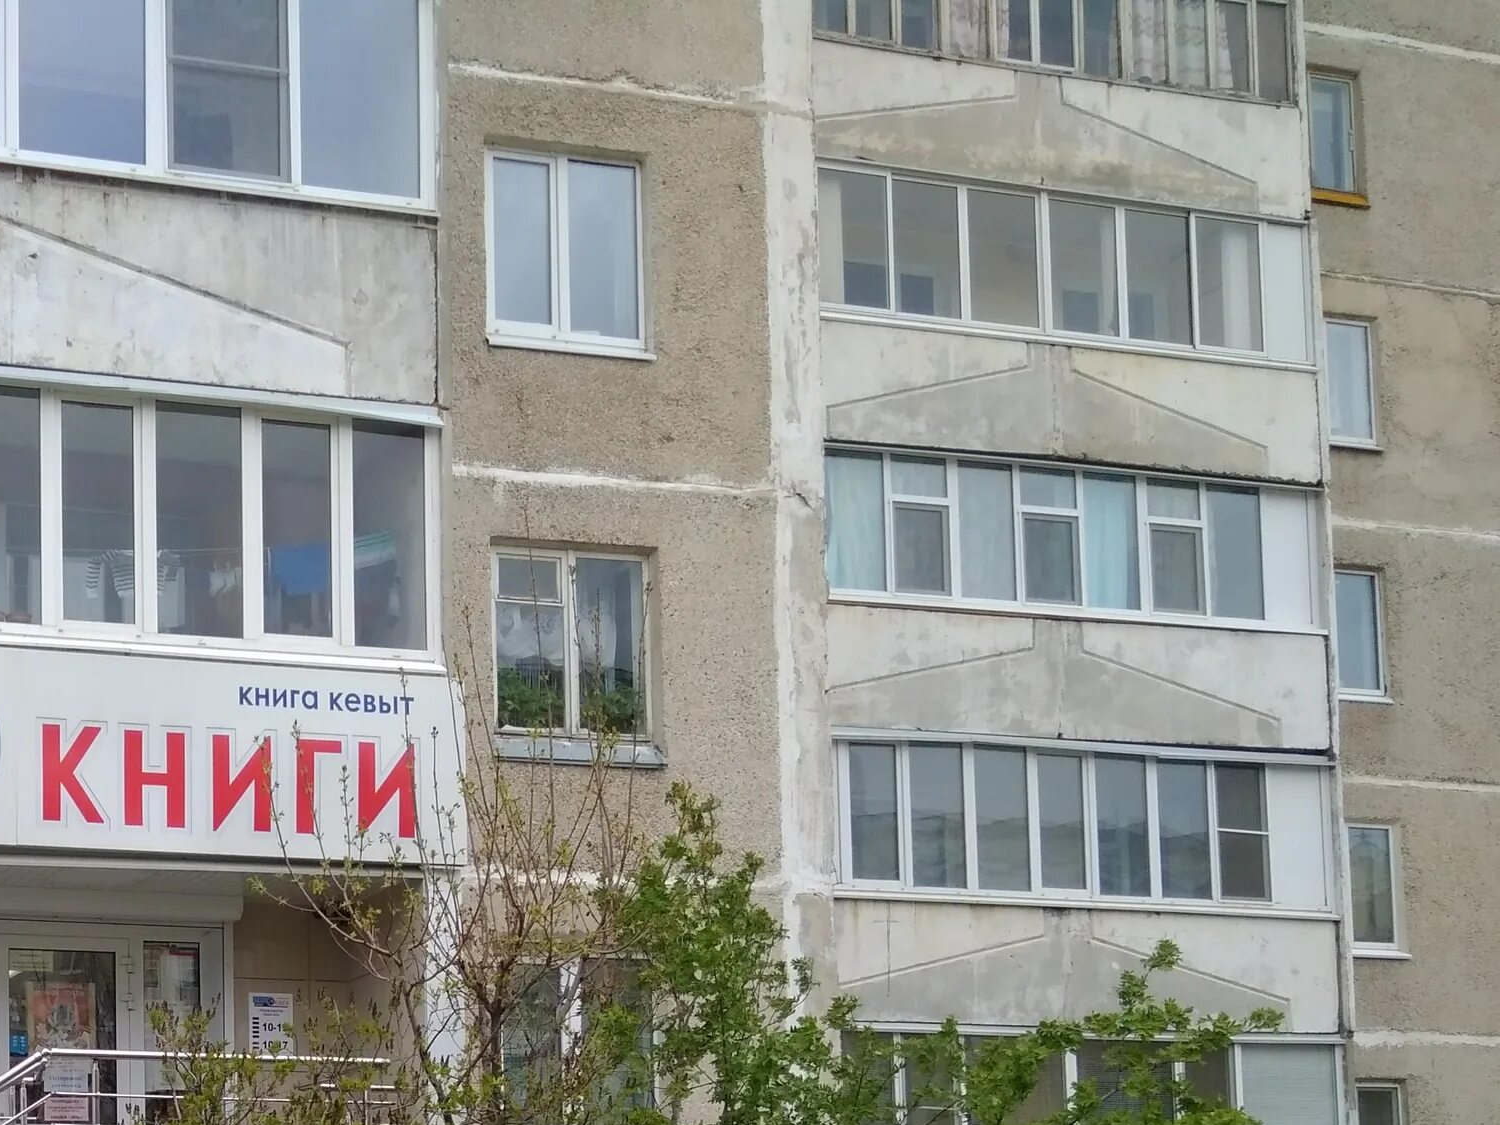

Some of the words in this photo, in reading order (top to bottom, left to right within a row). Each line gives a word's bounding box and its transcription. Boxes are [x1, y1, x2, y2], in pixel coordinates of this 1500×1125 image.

[238, 685, 319, 711] книга
[328, 691, 415, 716] кевыт
[39, 722, 417, 840] КНИГИ
